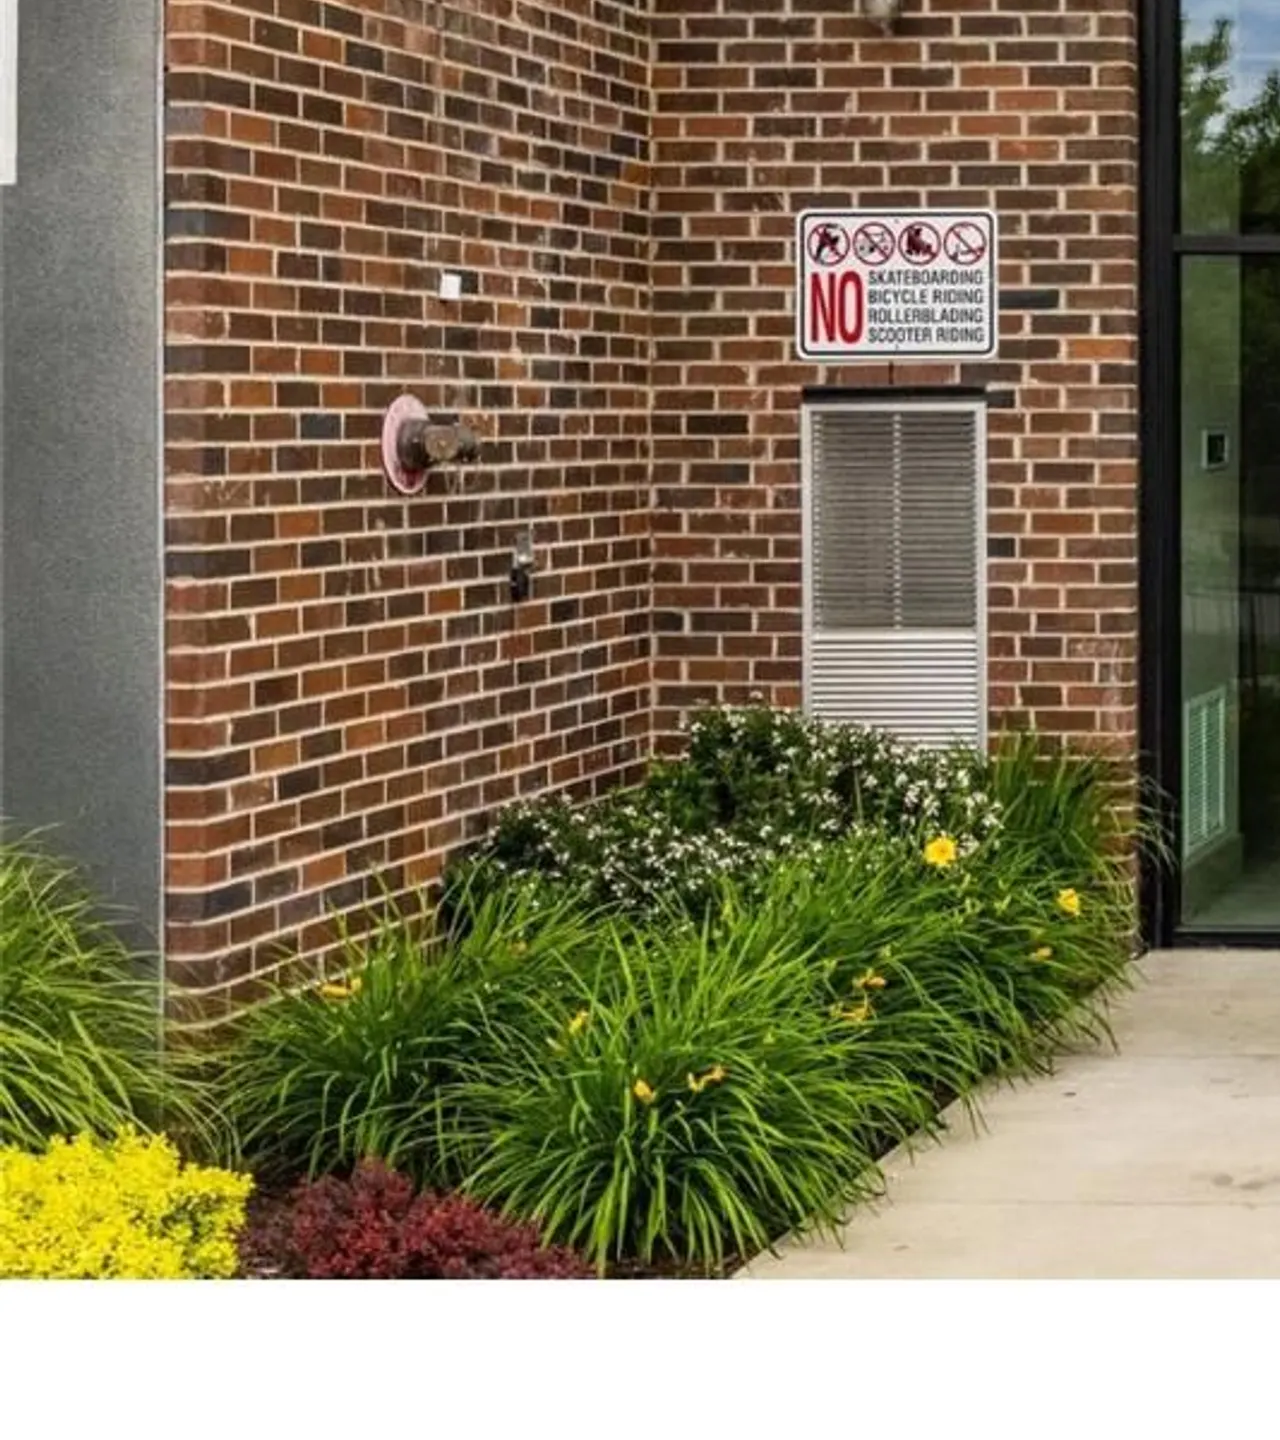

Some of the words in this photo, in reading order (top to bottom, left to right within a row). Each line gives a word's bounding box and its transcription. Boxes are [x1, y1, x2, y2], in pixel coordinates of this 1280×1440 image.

[868, 269, 984, 285] SKATEBOARDING
[868, 288, 928, 304] BICYCLE
[932, 288, 984, 304] RIDING
[811, 271, 864, 344] NO
[868, 308, 984, 324] ROLLERBLADING
[868, 327, 932, 343] SCOOTER
[936, 327, 985, 343] RIDING
